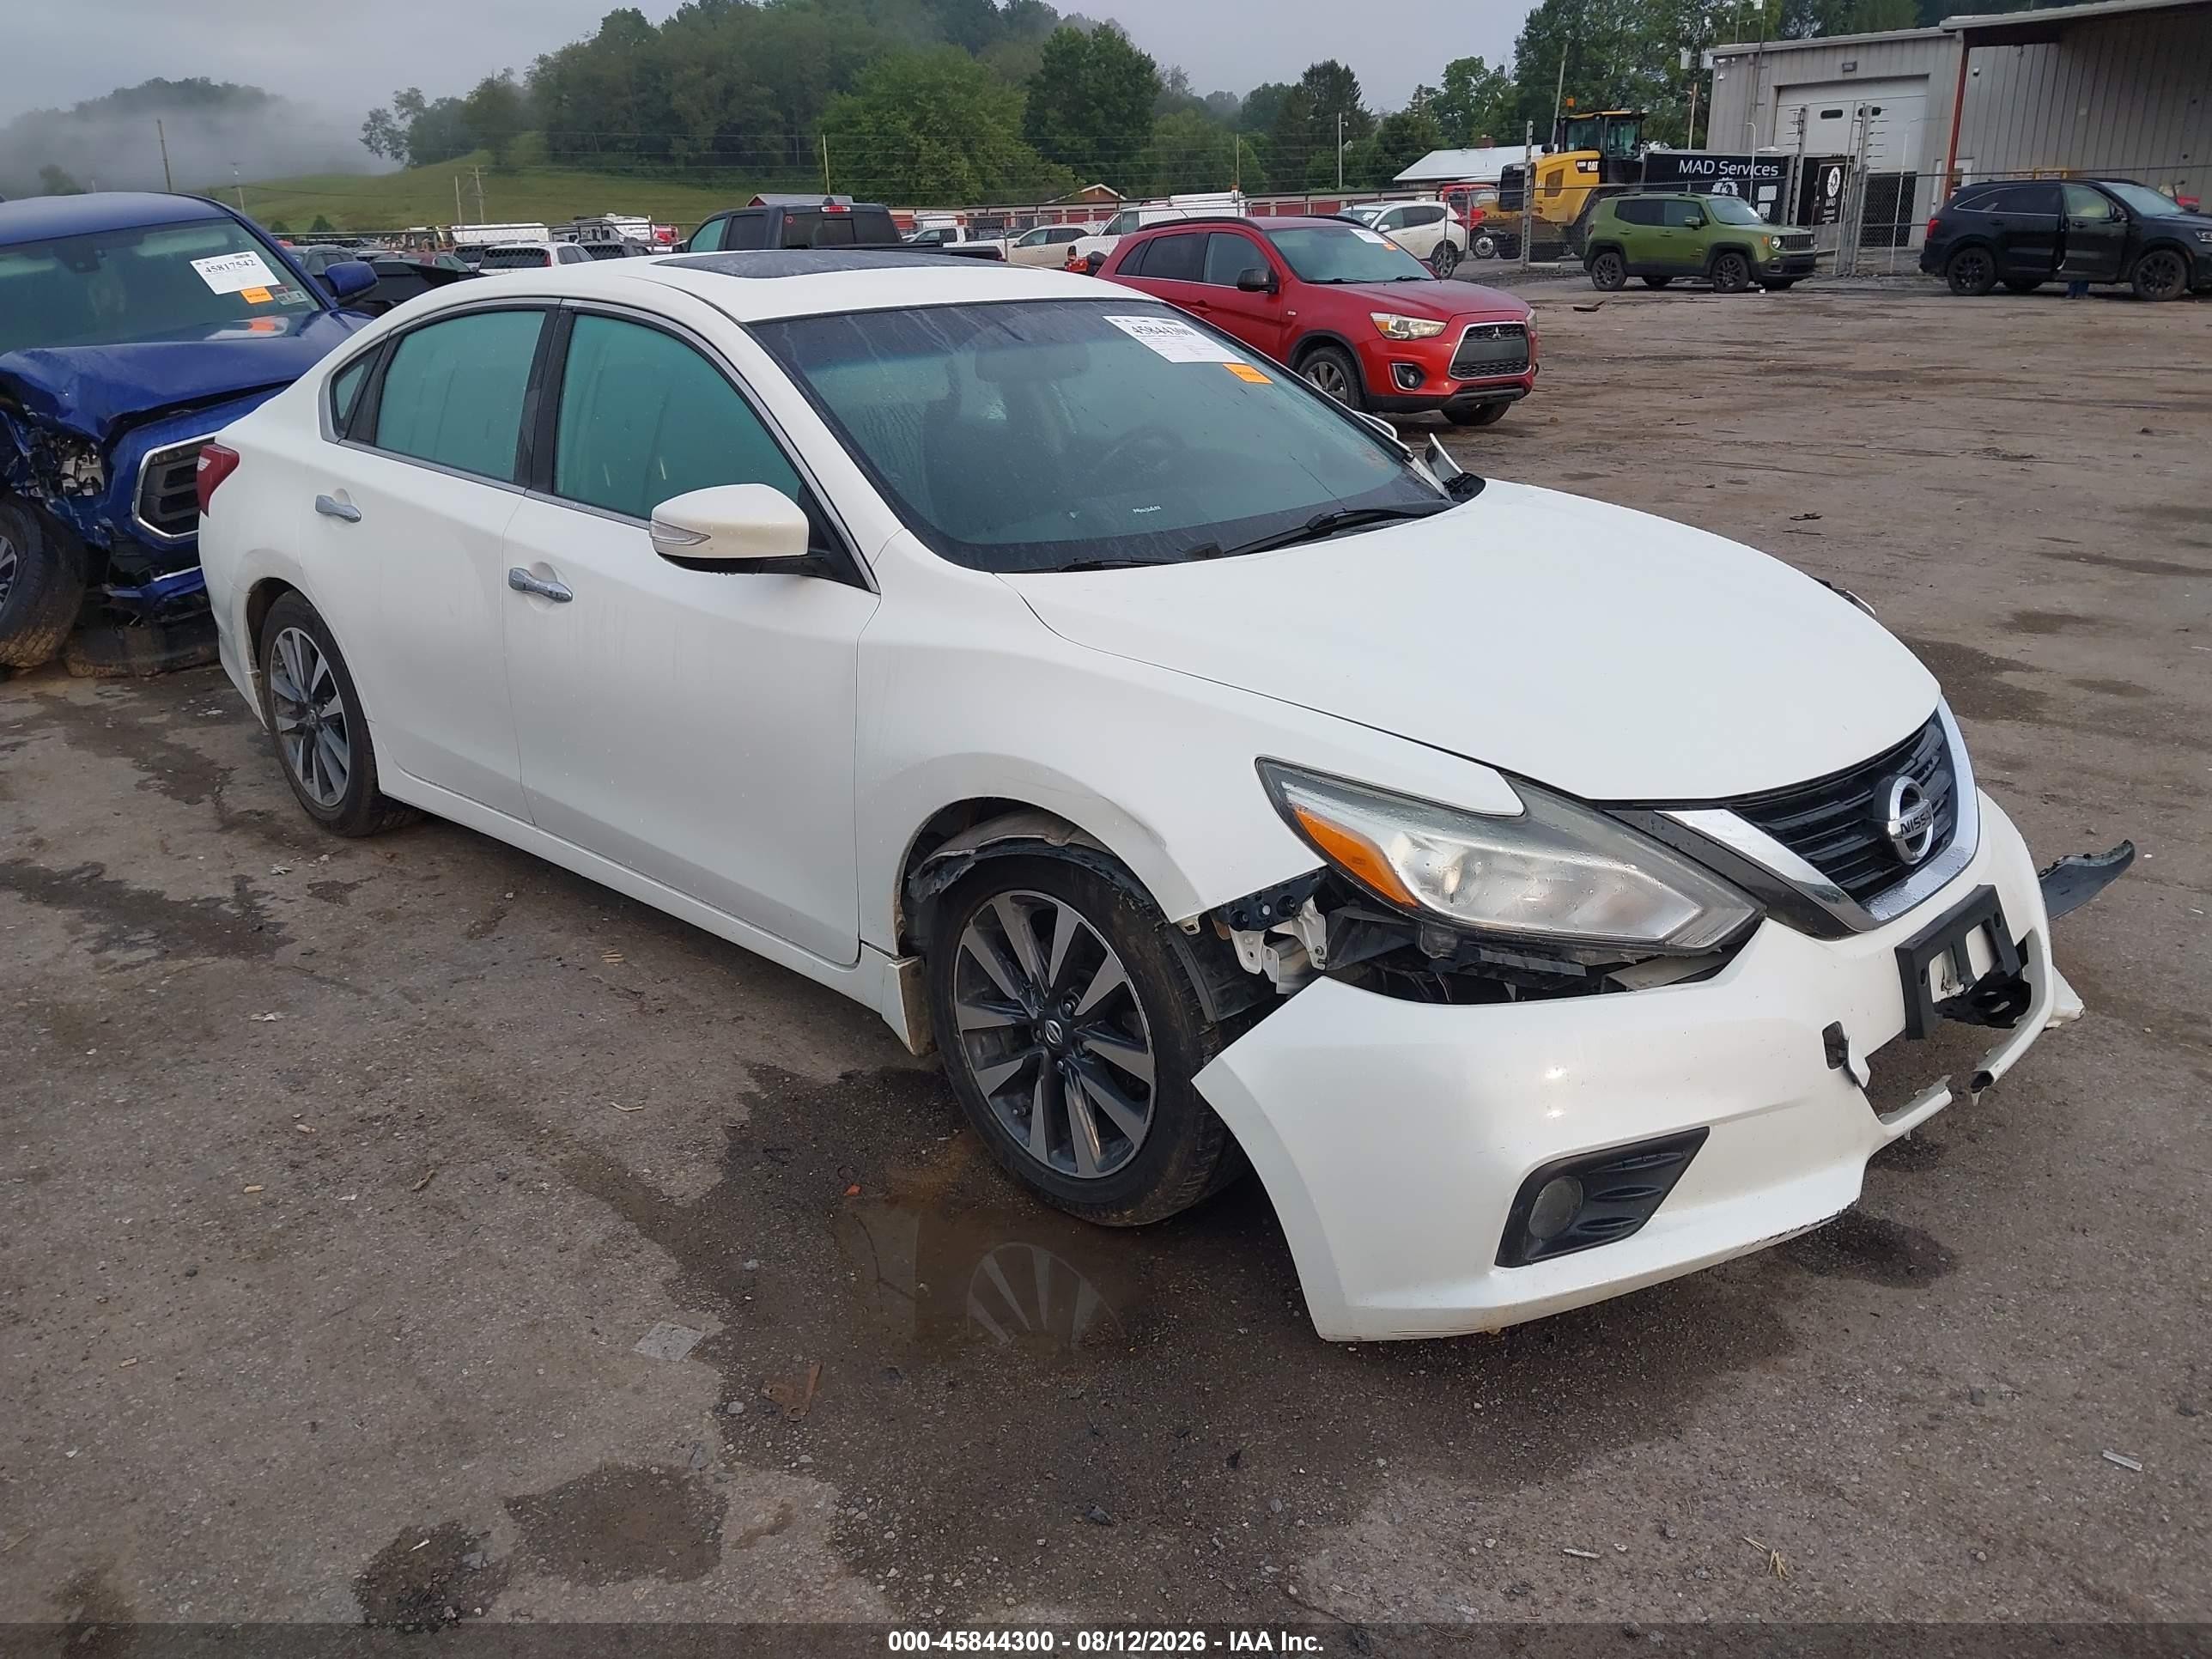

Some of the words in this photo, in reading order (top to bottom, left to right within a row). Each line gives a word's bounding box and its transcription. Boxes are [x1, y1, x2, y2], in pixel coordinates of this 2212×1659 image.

[1587, 161, 1599, 171] CAT
[1679, 159, 1715, 174] MAD
[205, 259, 257, 273] 45817542
